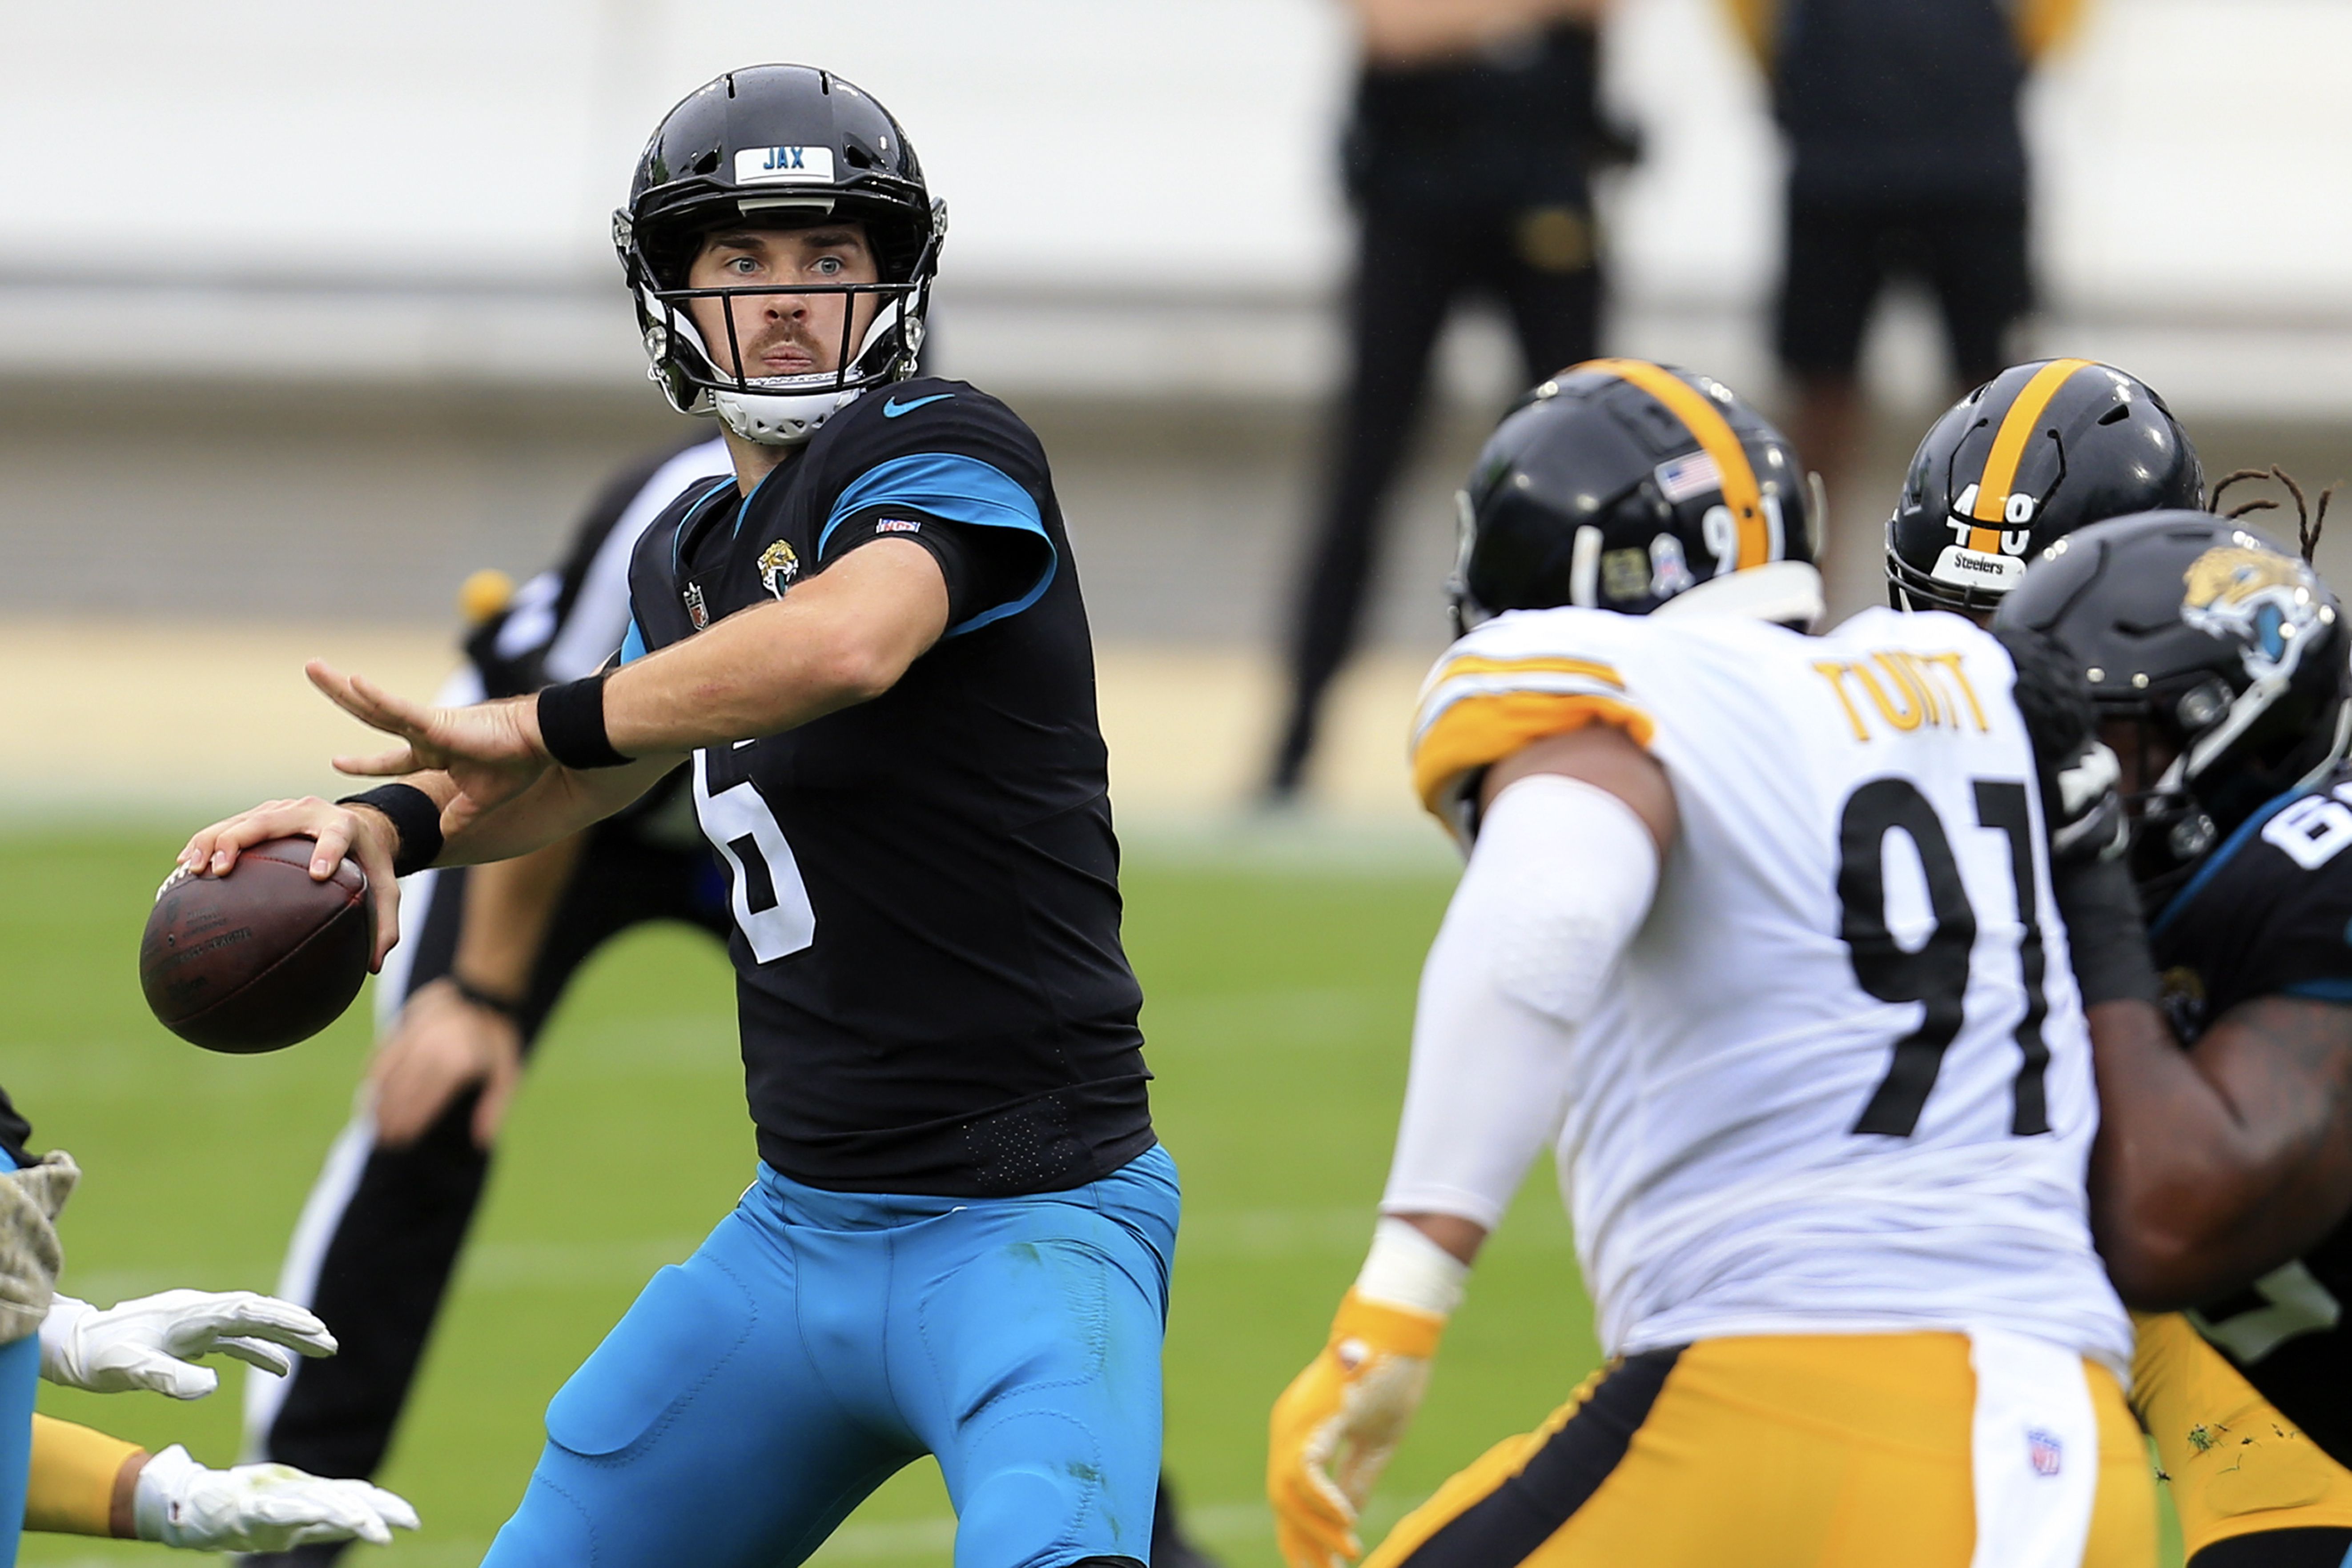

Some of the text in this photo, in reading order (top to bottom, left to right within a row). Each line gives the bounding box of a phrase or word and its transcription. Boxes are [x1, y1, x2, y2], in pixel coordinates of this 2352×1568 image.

[764, 146, 804, 169] JAX
[1954, 553, 2004, 575] Steelers
[692, 738, 817, 965] 6
[2261, 781, 2352, 870] 6
[1836, 777, 2054, 1137] 91
